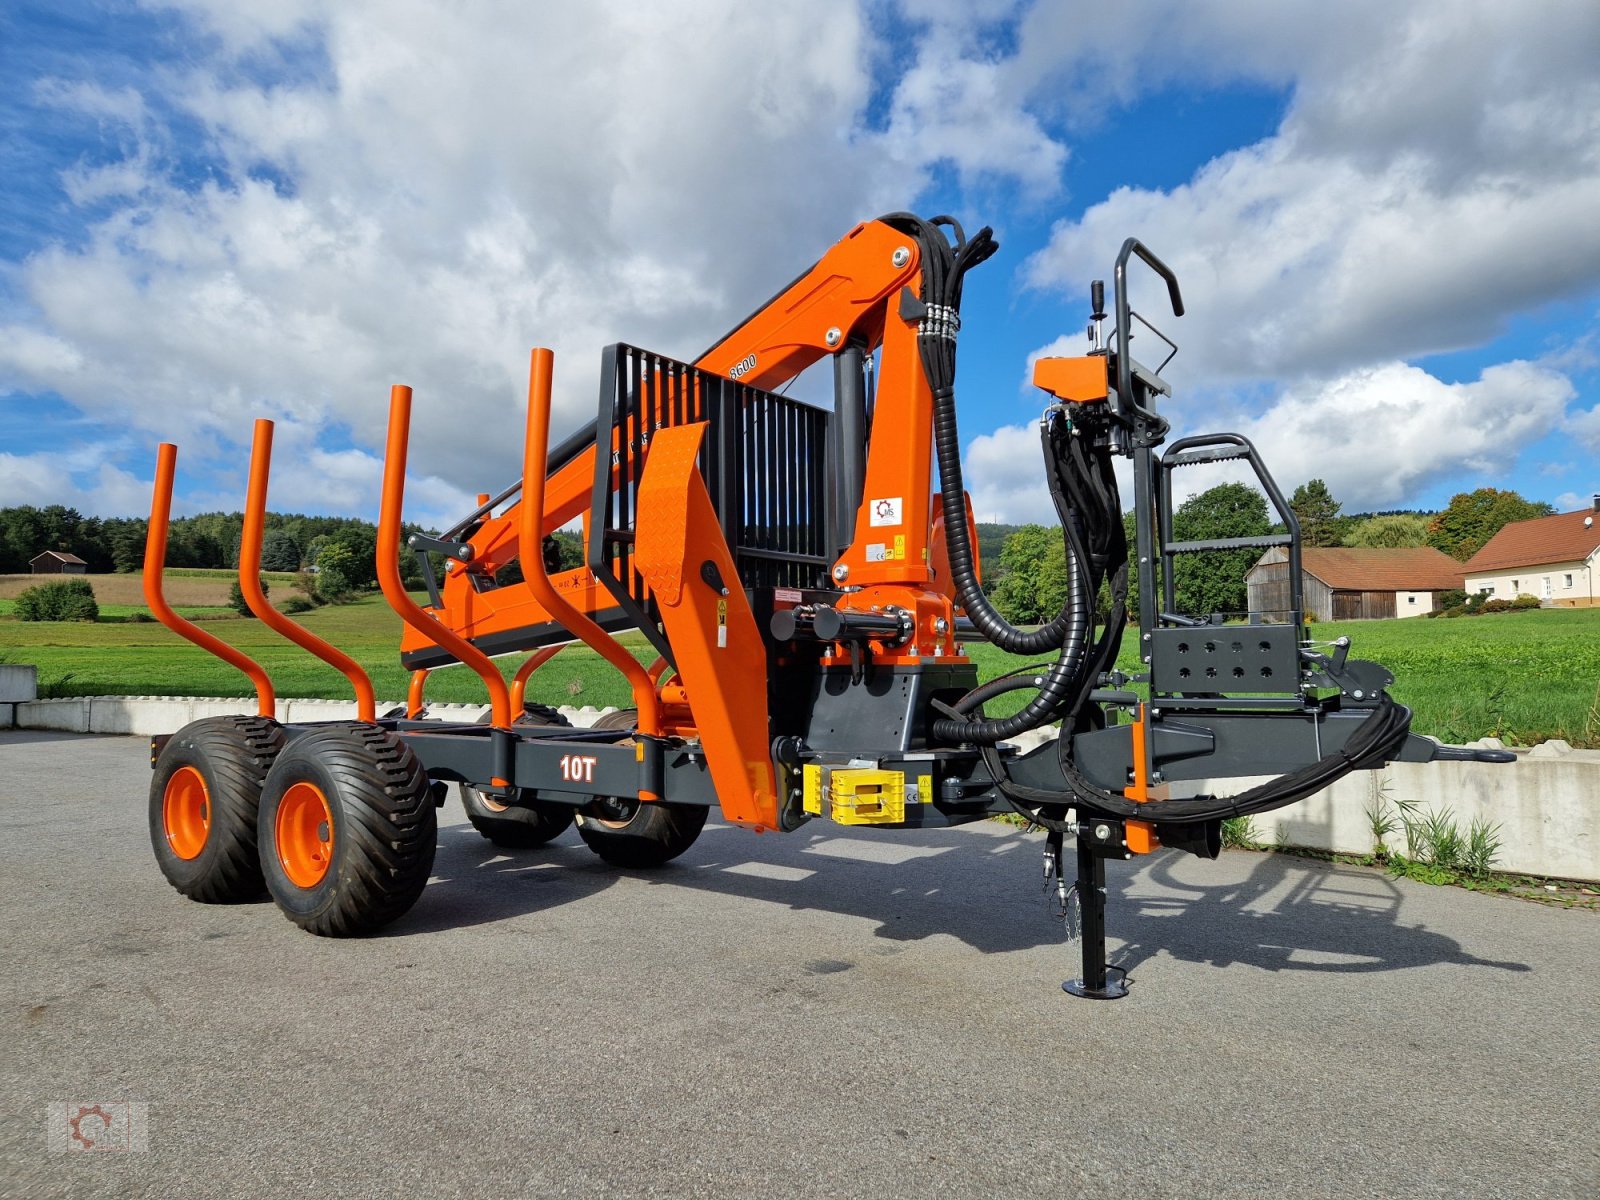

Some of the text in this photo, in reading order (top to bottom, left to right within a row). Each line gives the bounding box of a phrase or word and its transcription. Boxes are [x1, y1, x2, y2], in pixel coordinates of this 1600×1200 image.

[729, 353, 756, 380] 8600
[560, 754, 597, 783] 10T
[906, 793, 918, 801] CE
